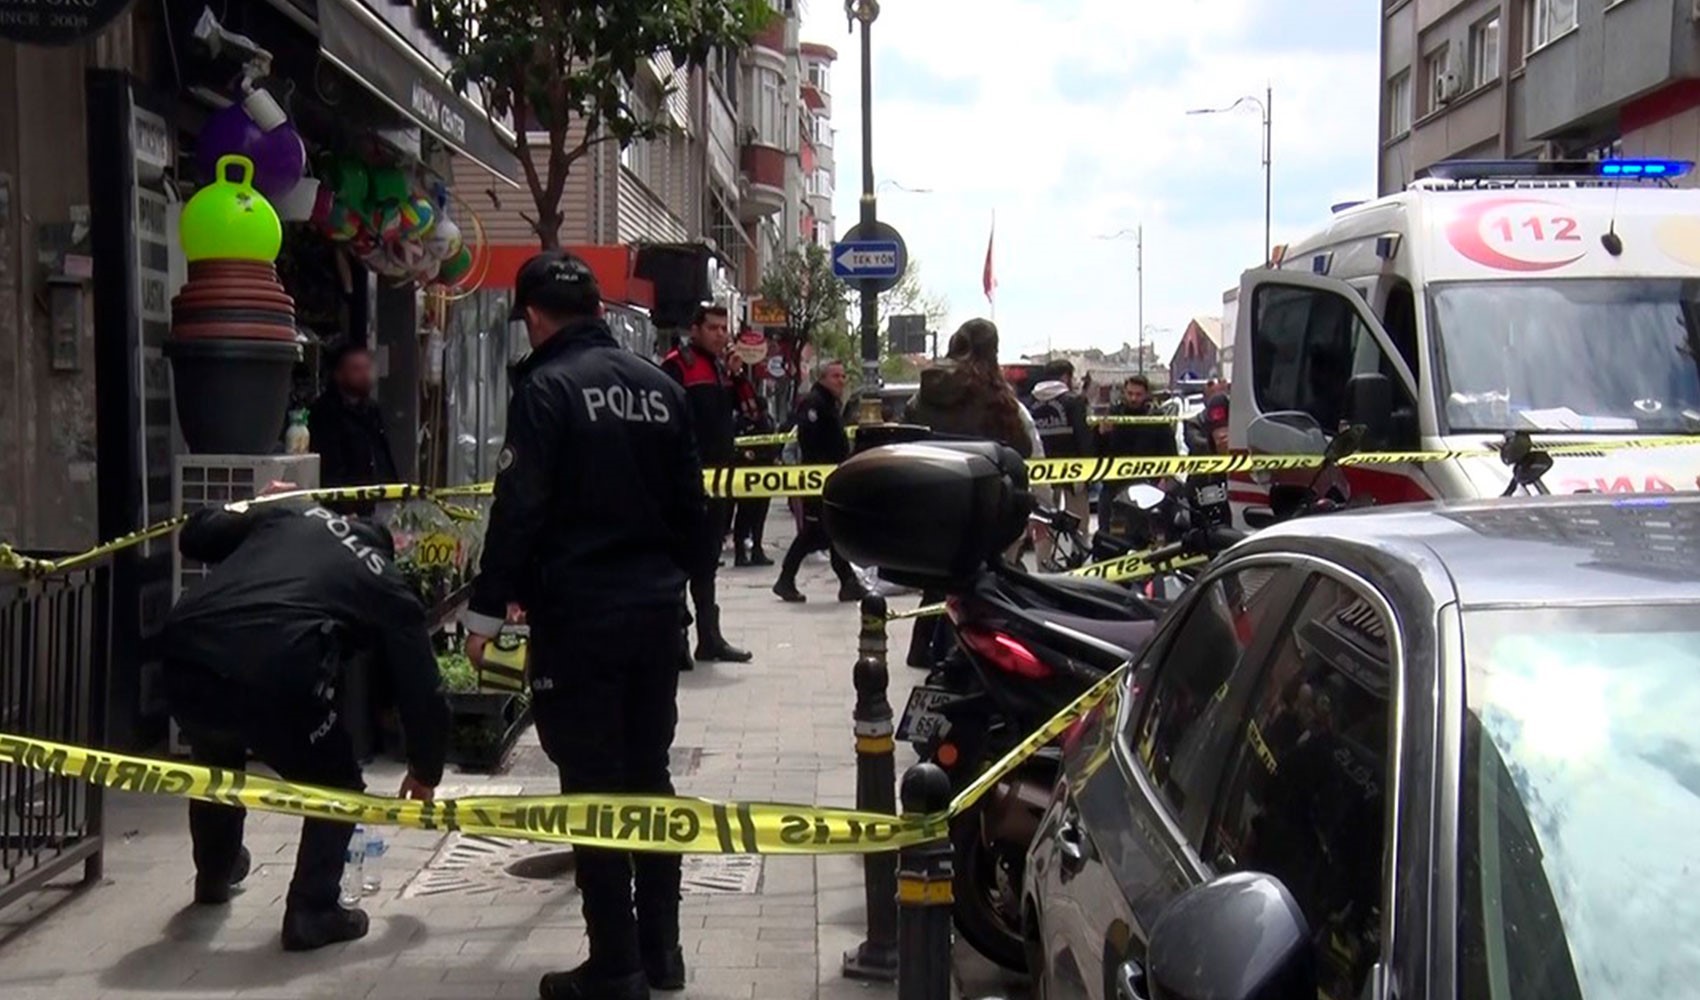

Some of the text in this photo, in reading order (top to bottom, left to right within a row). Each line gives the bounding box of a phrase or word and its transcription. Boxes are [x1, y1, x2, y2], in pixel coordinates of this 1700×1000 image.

[1489, 217, 1582, 243] 112
[853, 256, 871, 265] TEK
[1025, 462, 1083, 481] OLİS
